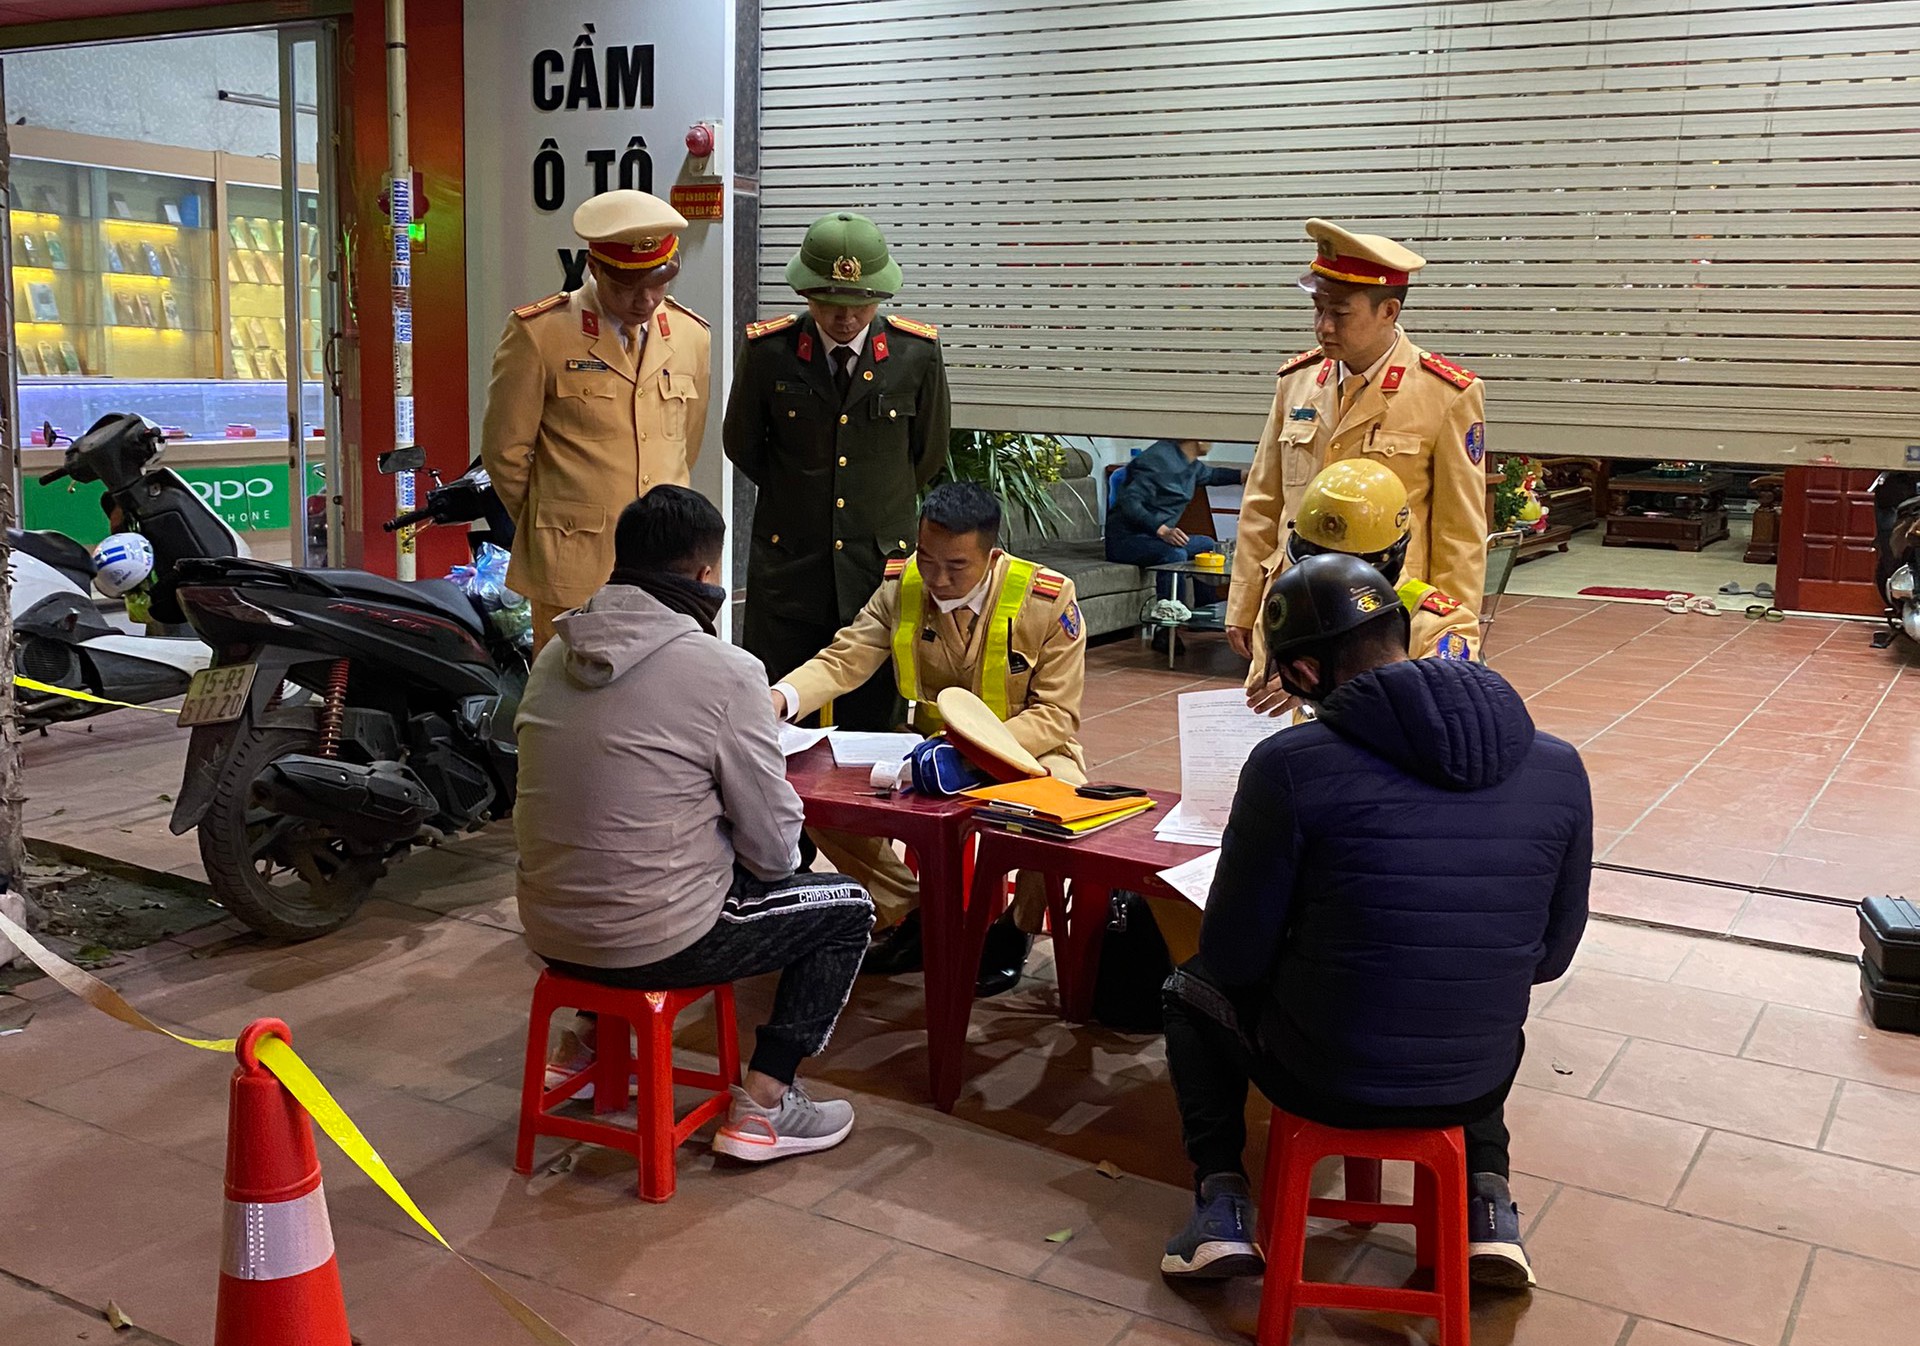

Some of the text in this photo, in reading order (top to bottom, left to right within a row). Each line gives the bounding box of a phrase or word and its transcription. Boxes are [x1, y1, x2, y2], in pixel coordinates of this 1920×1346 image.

[533, 23, 655, 111] CẦM
[533, 136, 653, 211] Ô TÔ
[557, 249, 590, 292] X
[200, 668, 246, 695] 15-B3
